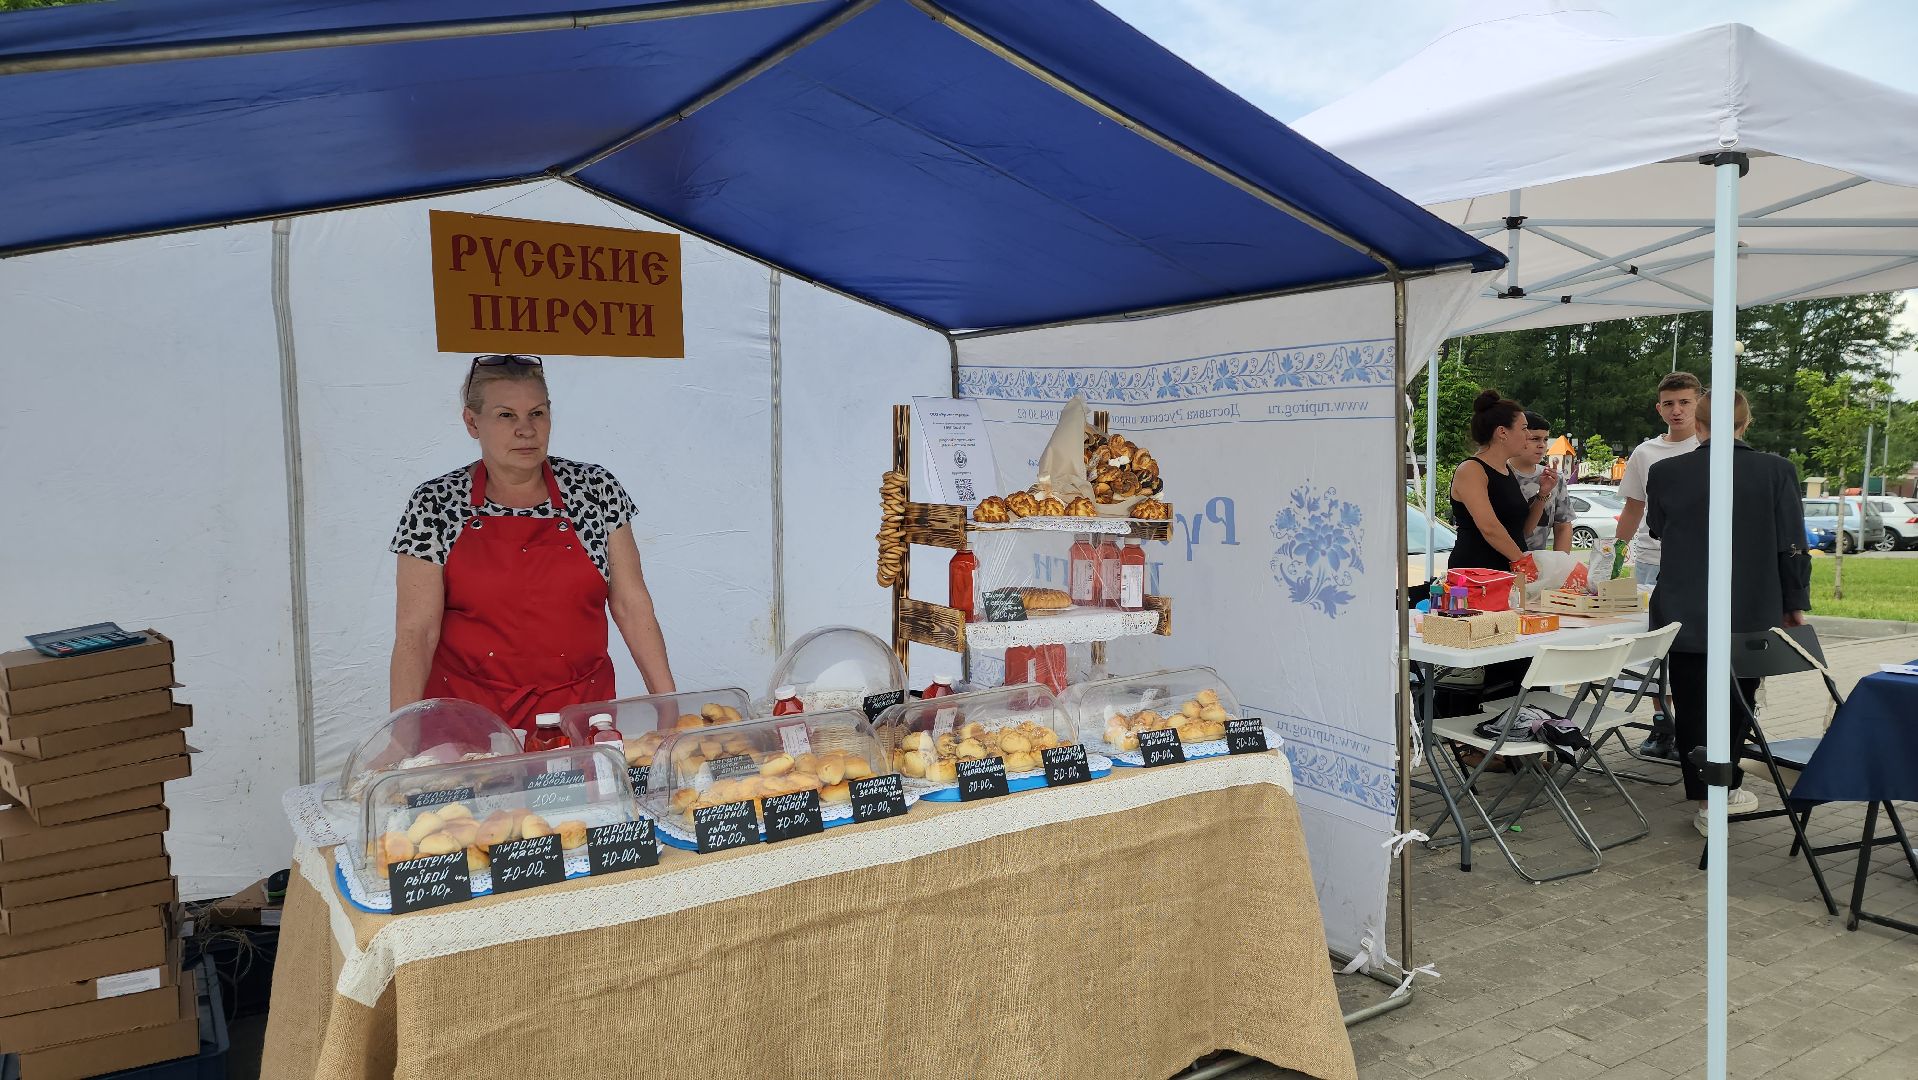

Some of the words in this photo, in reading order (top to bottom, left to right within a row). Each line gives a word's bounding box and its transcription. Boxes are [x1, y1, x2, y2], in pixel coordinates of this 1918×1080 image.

[449, 234, 669, 286] РУССКИЕ
[468, 293, 656, 337] ПИРОГИ
[856, 776, 897, 790] ПИРОЖОК
[695, 801, 748, 817] ПИРОЖОК
[765, 791, 810, 808] БУЛОЧКА
[775, 801, 808, 814] СЫРОМ
[592, 820, 650, 839] ПИРОЖОК
[595, 827, 650, 847] КУРИЦЕЙ
[495, 835, 554, 855] ПИРОЖОК
[507, 844, 552, 861] МЯСОМ
[394, 850, 464, 874] РАССТЕГАЙ
